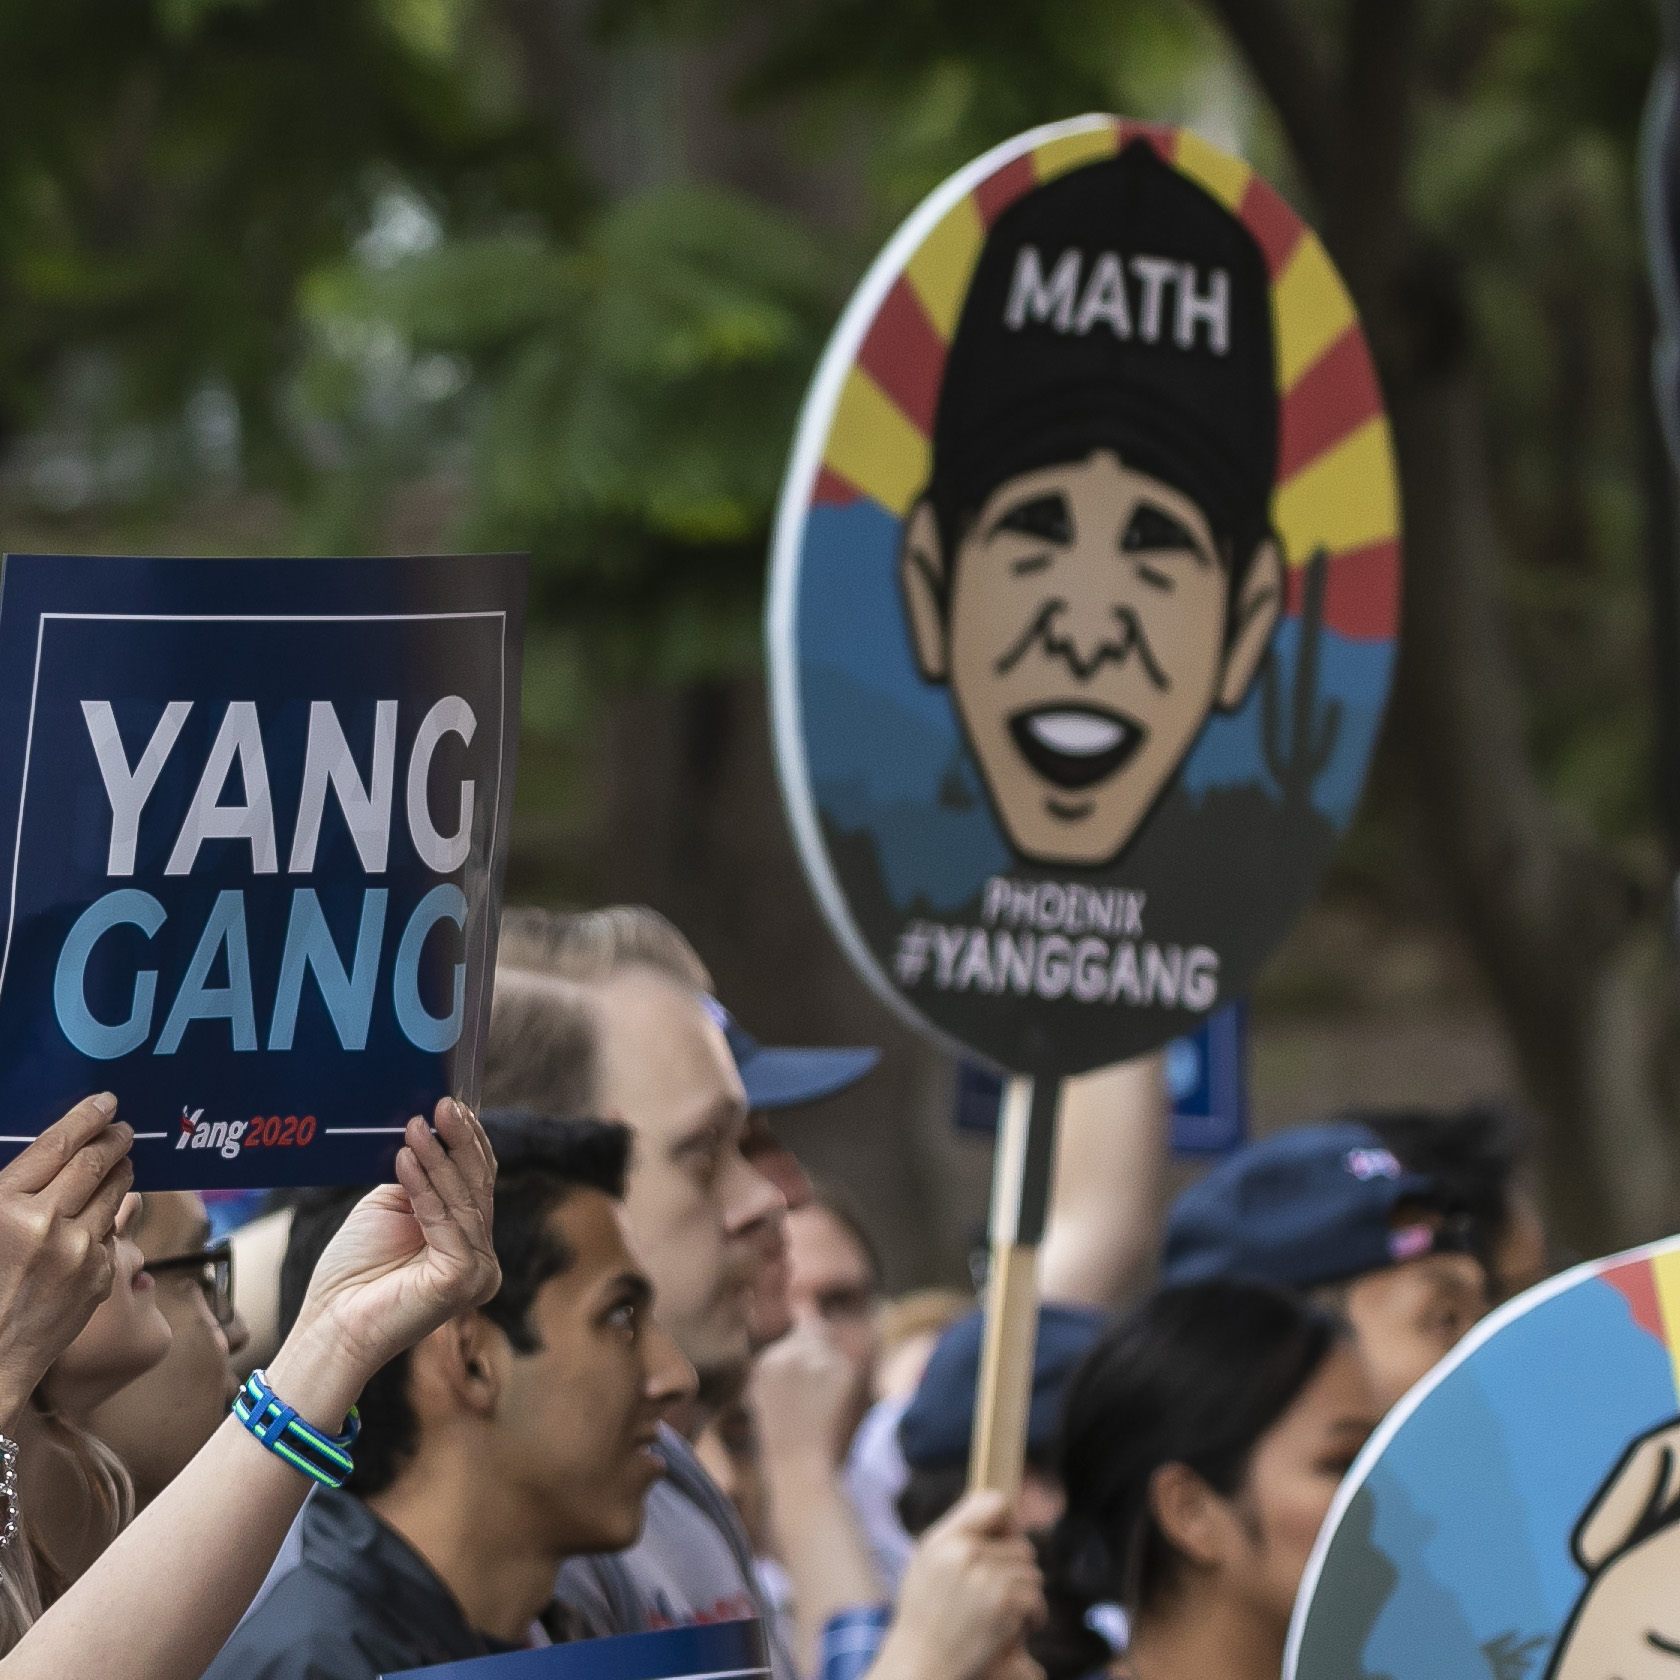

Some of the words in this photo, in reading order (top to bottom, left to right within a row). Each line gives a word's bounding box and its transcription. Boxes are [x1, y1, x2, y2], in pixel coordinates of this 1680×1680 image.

[1003, 243, 1230, 357] MATH
[80, 694, 478, 876] YANG
[981, 875, 1147, 937] PHOENIX
[52, 882, 469, 1060] GANG
[892, 922, 1220, 1013] #YANGGANG
[175, 1104, 316, 1158] Yang2020
